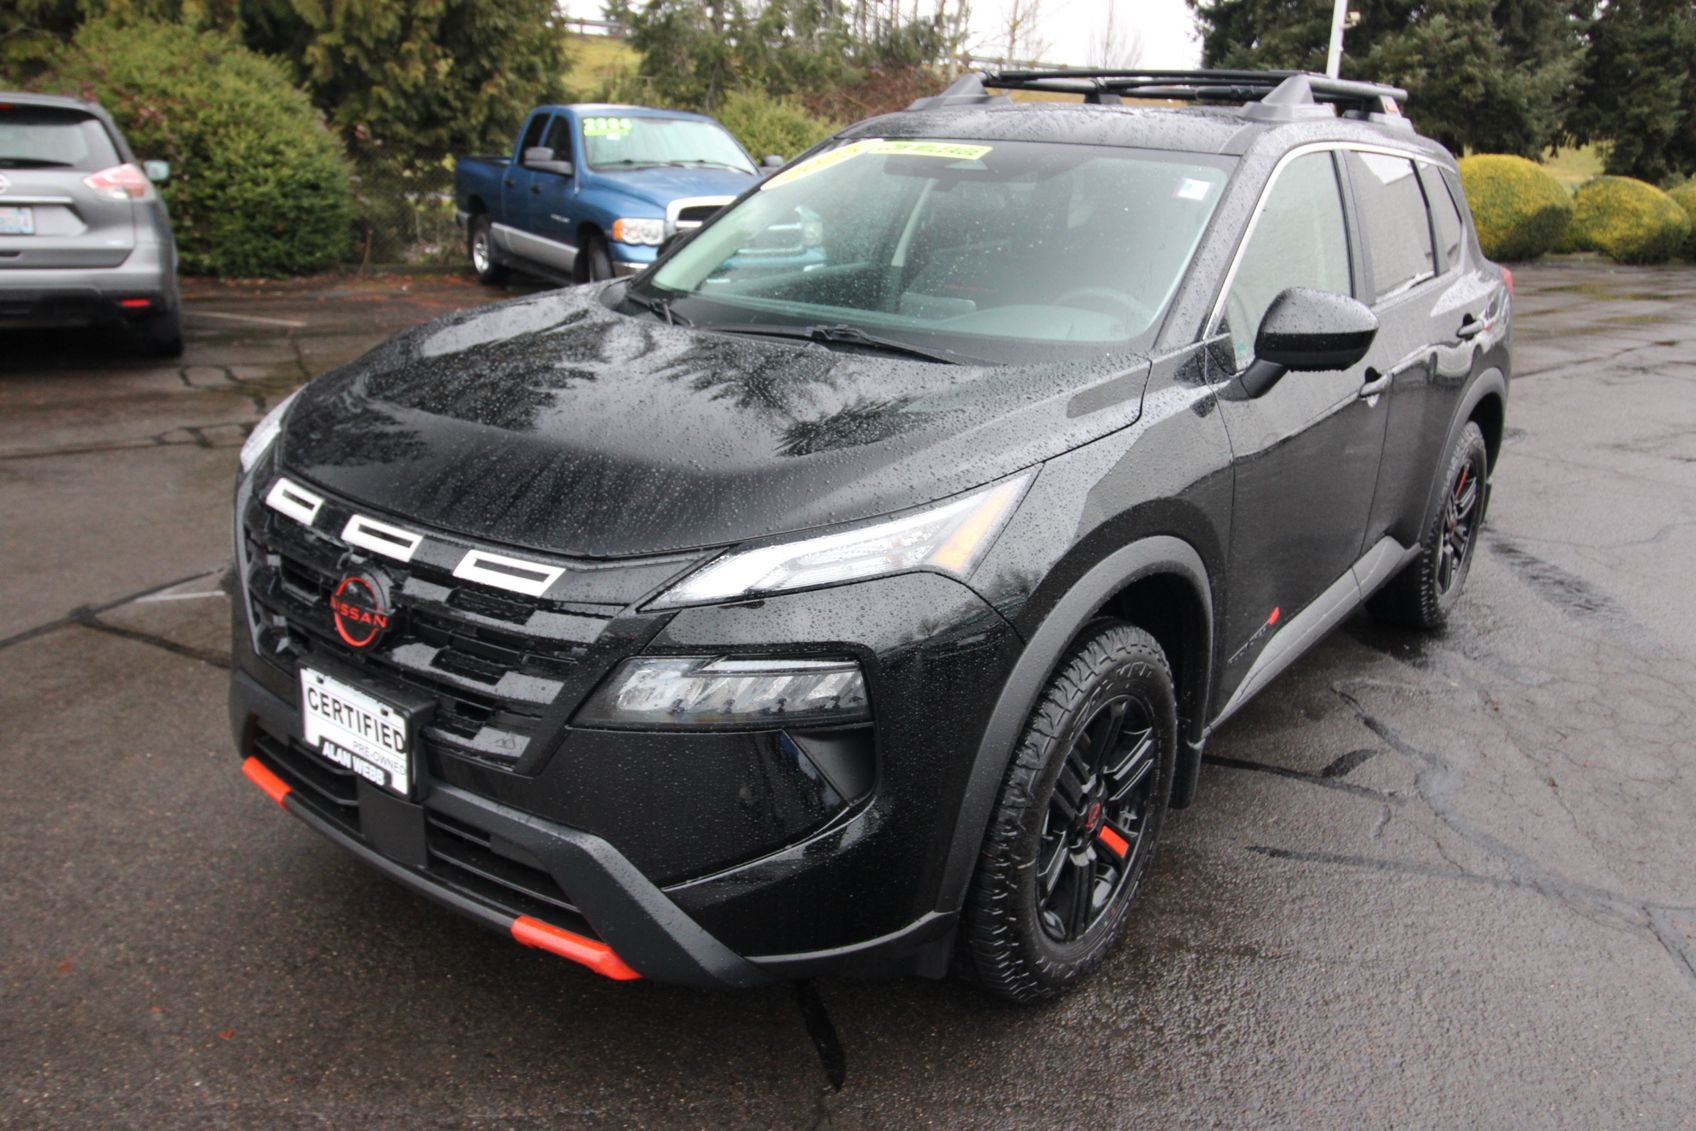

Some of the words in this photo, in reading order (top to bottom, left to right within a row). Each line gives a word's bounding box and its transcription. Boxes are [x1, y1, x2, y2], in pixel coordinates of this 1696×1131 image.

[307, 687, 406, 754] CERTIFIED
[323, 741, 351, 768] ALAN
[352, 756, 384, 786] WEBB
